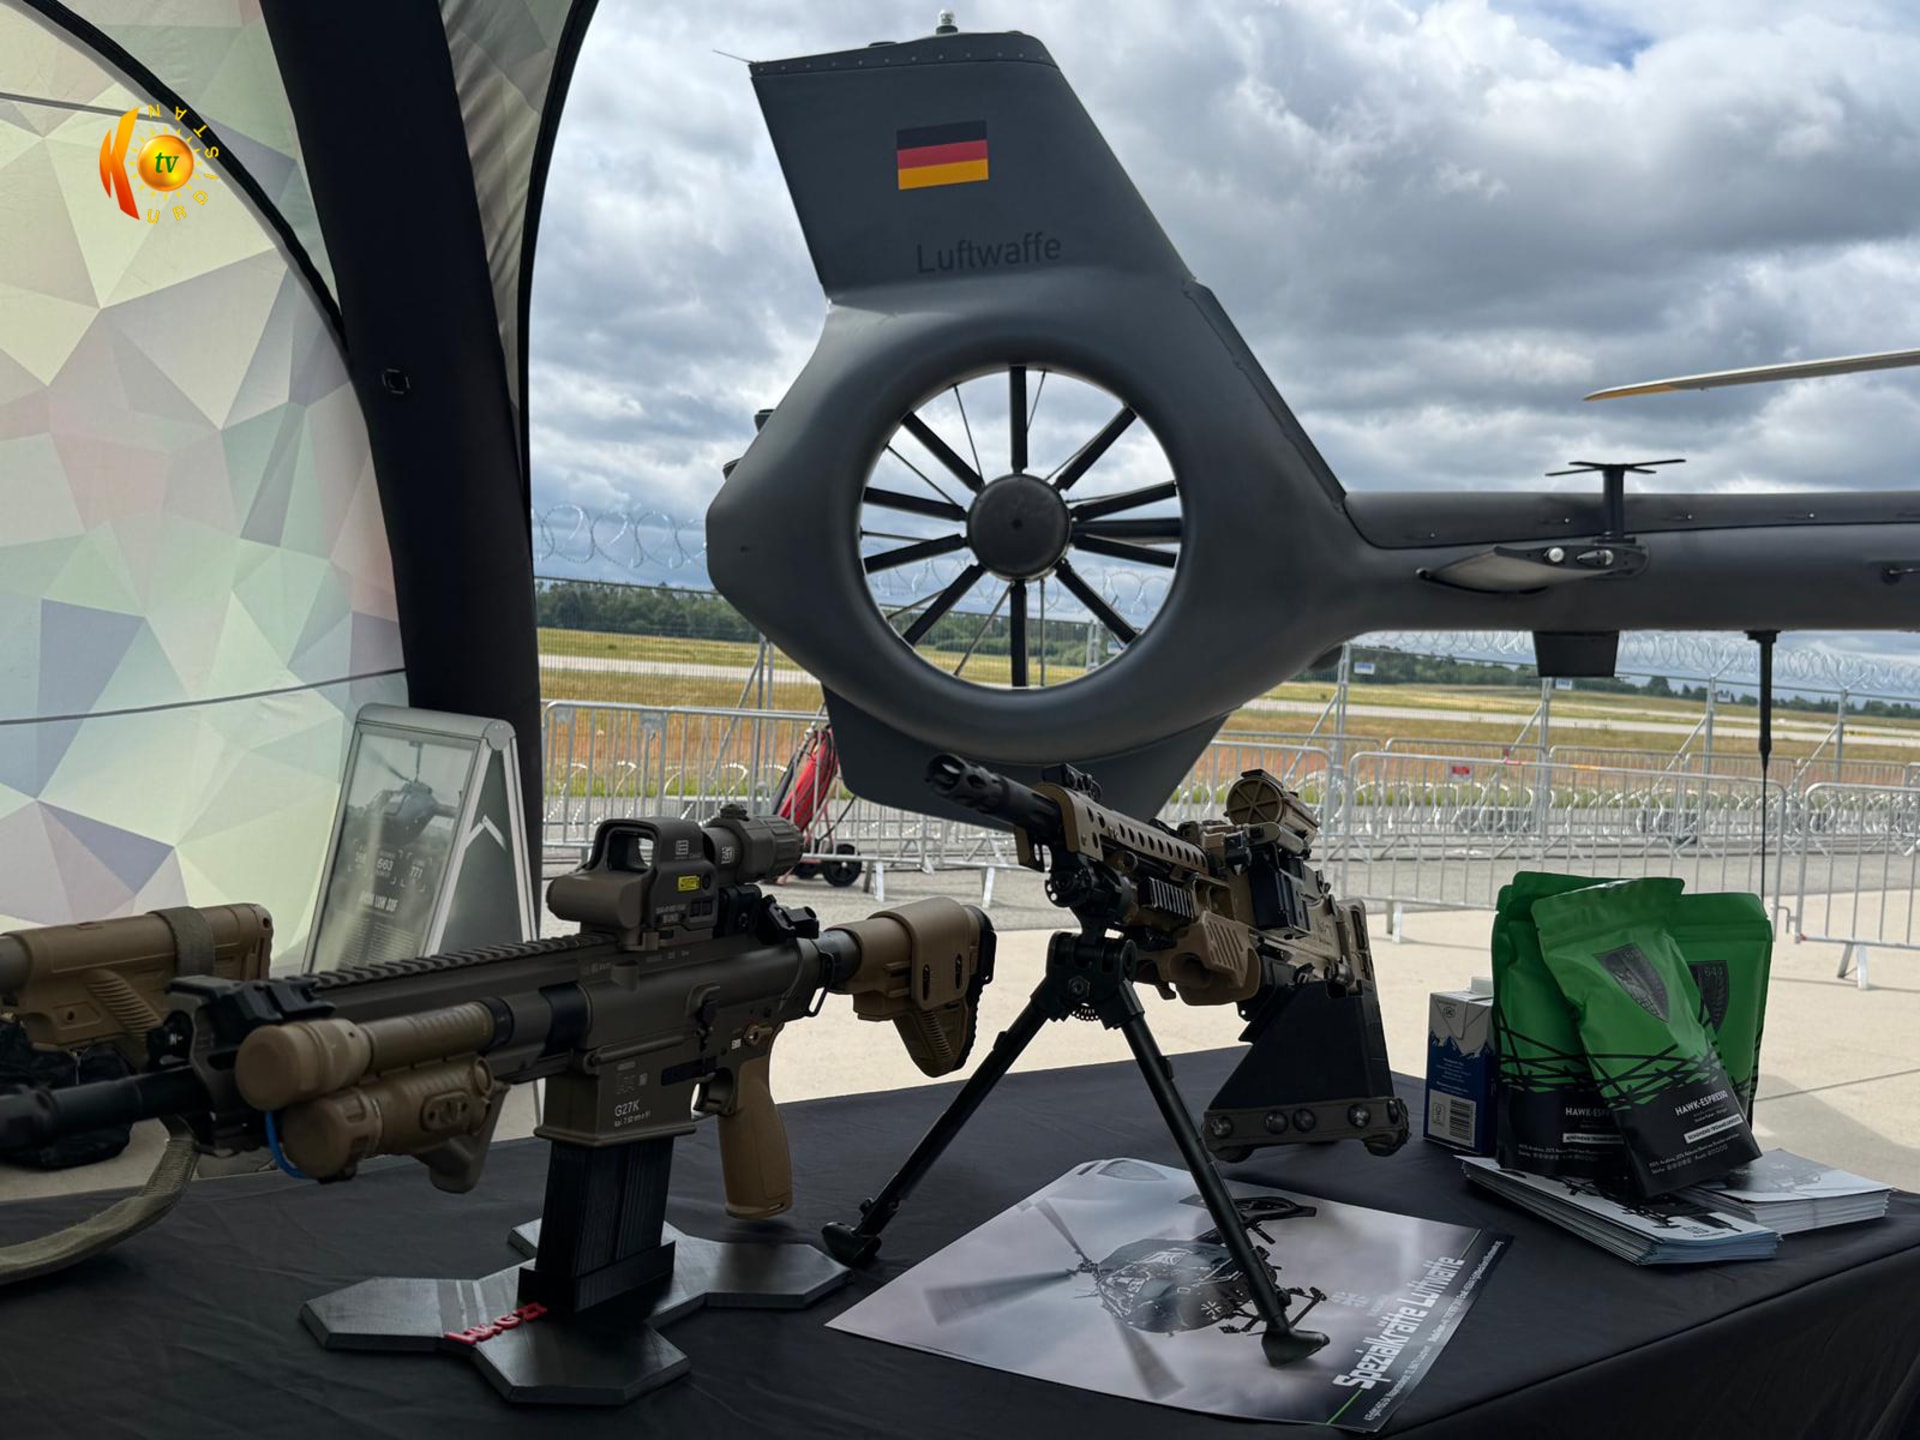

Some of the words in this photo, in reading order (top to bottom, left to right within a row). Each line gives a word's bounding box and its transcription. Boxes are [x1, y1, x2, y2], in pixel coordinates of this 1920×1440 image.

[916, 231, 1062, 274] Luftwaffe
[614, 1099, 640, 1117] G27K
[1332, 1304, 1429, 1390] Spezialkräfte
[1396, 1256, 1465, 1308] Luftwaffe
